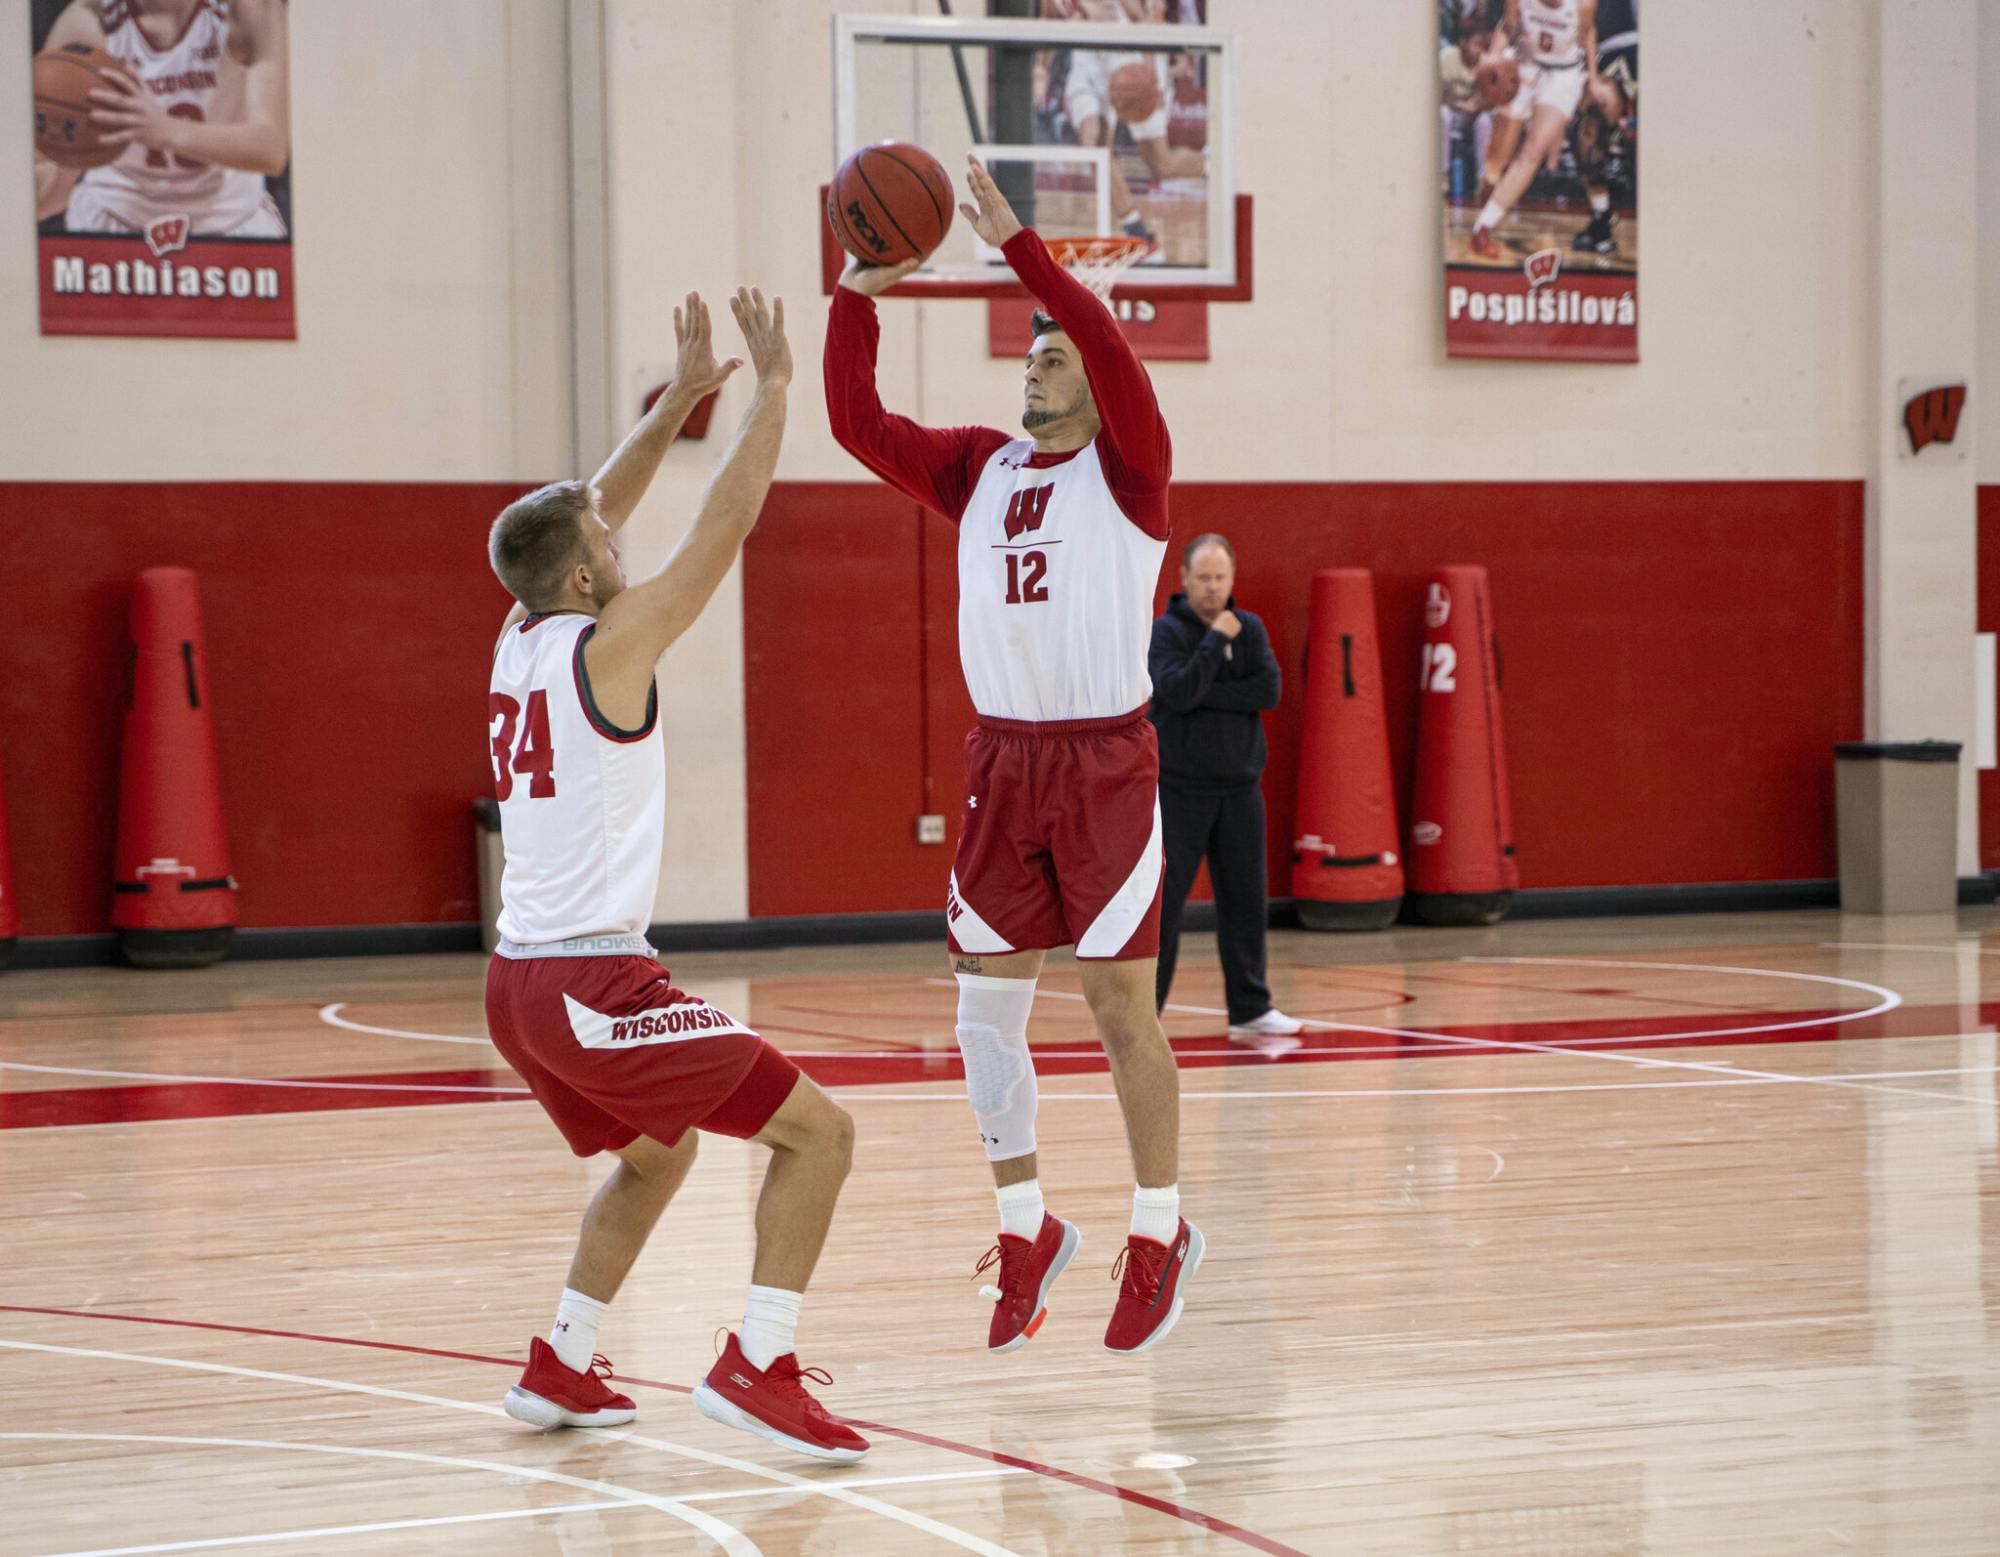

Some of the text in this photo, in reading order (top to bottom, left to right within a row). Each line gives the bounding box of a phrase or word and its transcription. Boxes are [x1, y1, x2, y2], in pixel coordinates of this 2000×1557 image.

[53, 256, 279, 299] Mathiason
[1448, 286, 1636, 326] Pospíšilová
[1903, 385, 1967, 456] W
[1004, 481, 1055, 543] W
[1005, 550, 1048, 604] 12
[489, 688, 556, 803] 34
[611, 1007, 734, 1041] WISCONSIN
